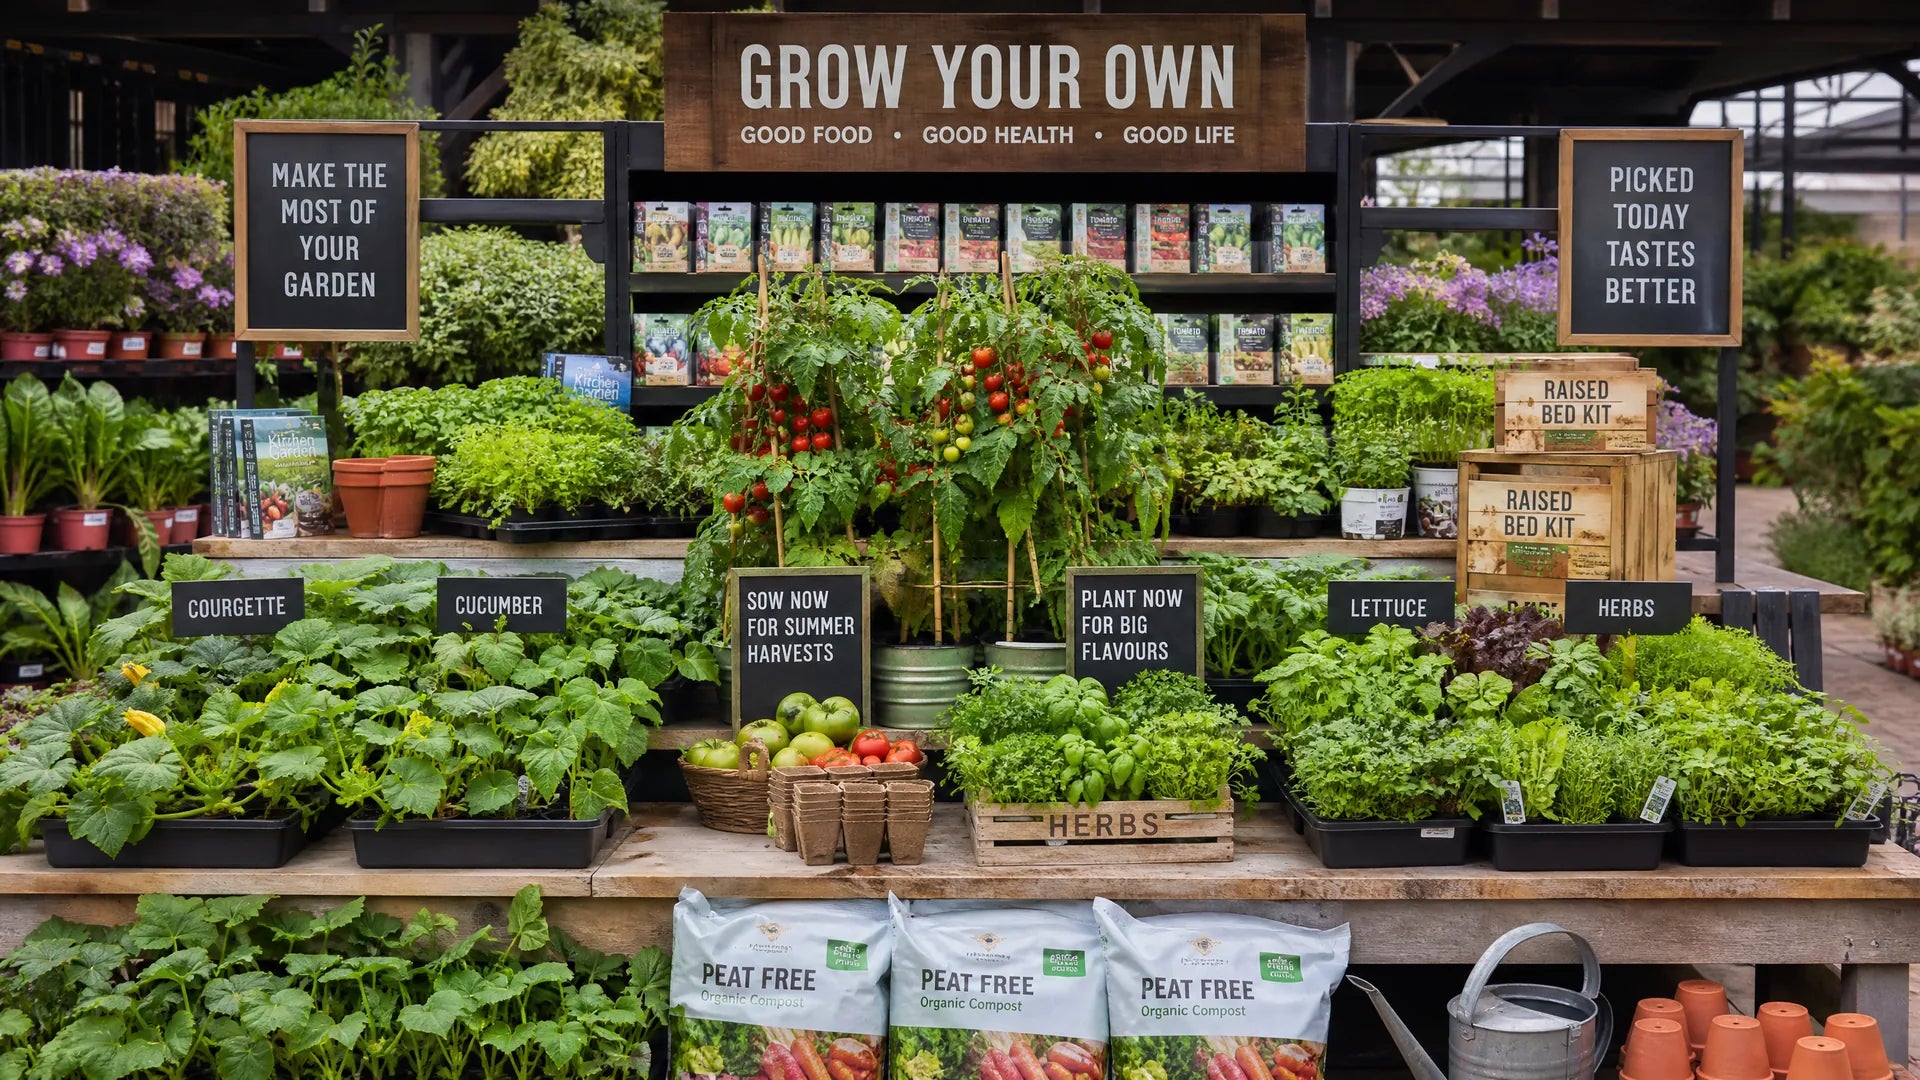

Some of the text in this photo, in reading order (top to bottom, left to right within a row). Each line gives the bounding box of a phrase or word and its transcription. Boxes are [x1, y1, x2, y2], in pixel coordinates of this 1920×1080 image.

[741, 44, 1234, 109] GROW YOUR OWN
[741, 126, 1234, 144] GOOD FOOD GOOD HEALTH GOOD LIFE
[272, 163, 387, 188] MAKE THE
[1610, 167, 1694, 193] PICKED
[281, 199, 377, 224] MOST OF
[1613, 204, 1690, 230] TODAY
[299, 236, 360, 261] YOUR
[1606, 241, 1695, 267] TASTES
[284, 272, 376, 297] GARDEN
[1605, 278, 1696, 304] BETTER
[1544, 380, 1609, 400] RAISED
[1542, 404, 1612, 424] BED KIT
[1507, 489, 1572, 512] RAISED
[1504, 515, 1576, 538] BED KIT
[188, 595, 286, 618] COURGETTE
[455, 595, 543, 616] CUCUMBER
[747, 590, 829, 611] SOW NOW
[1081, 589, 1183, 609] PLANT NOW
[1351, 598, 1427, 618] LETTUCE
[1598, 598, 1655, 618] HERBS
[747, 616, 855, 637] FOR SUMMER
[1081, 615, 1148, 635] FOR BIG
[747, 643, 834, 664] HARVESTS
[1081, 641, 1169, 661] FLAVOURS
[1049, 812, 1159, 838] HERBS
[702, 963, 816, 992] PEAT FREE
[921, 968, 1034, 996] PEAT FREE
[1141, 977, 1255, 1000] PEAT FREE
[701, 989, 805, 1009] Organic Compost
[920, 996, 1023, 1014] Organic Compost
[1140, 1004, 1247, 1020] Organic Compost
